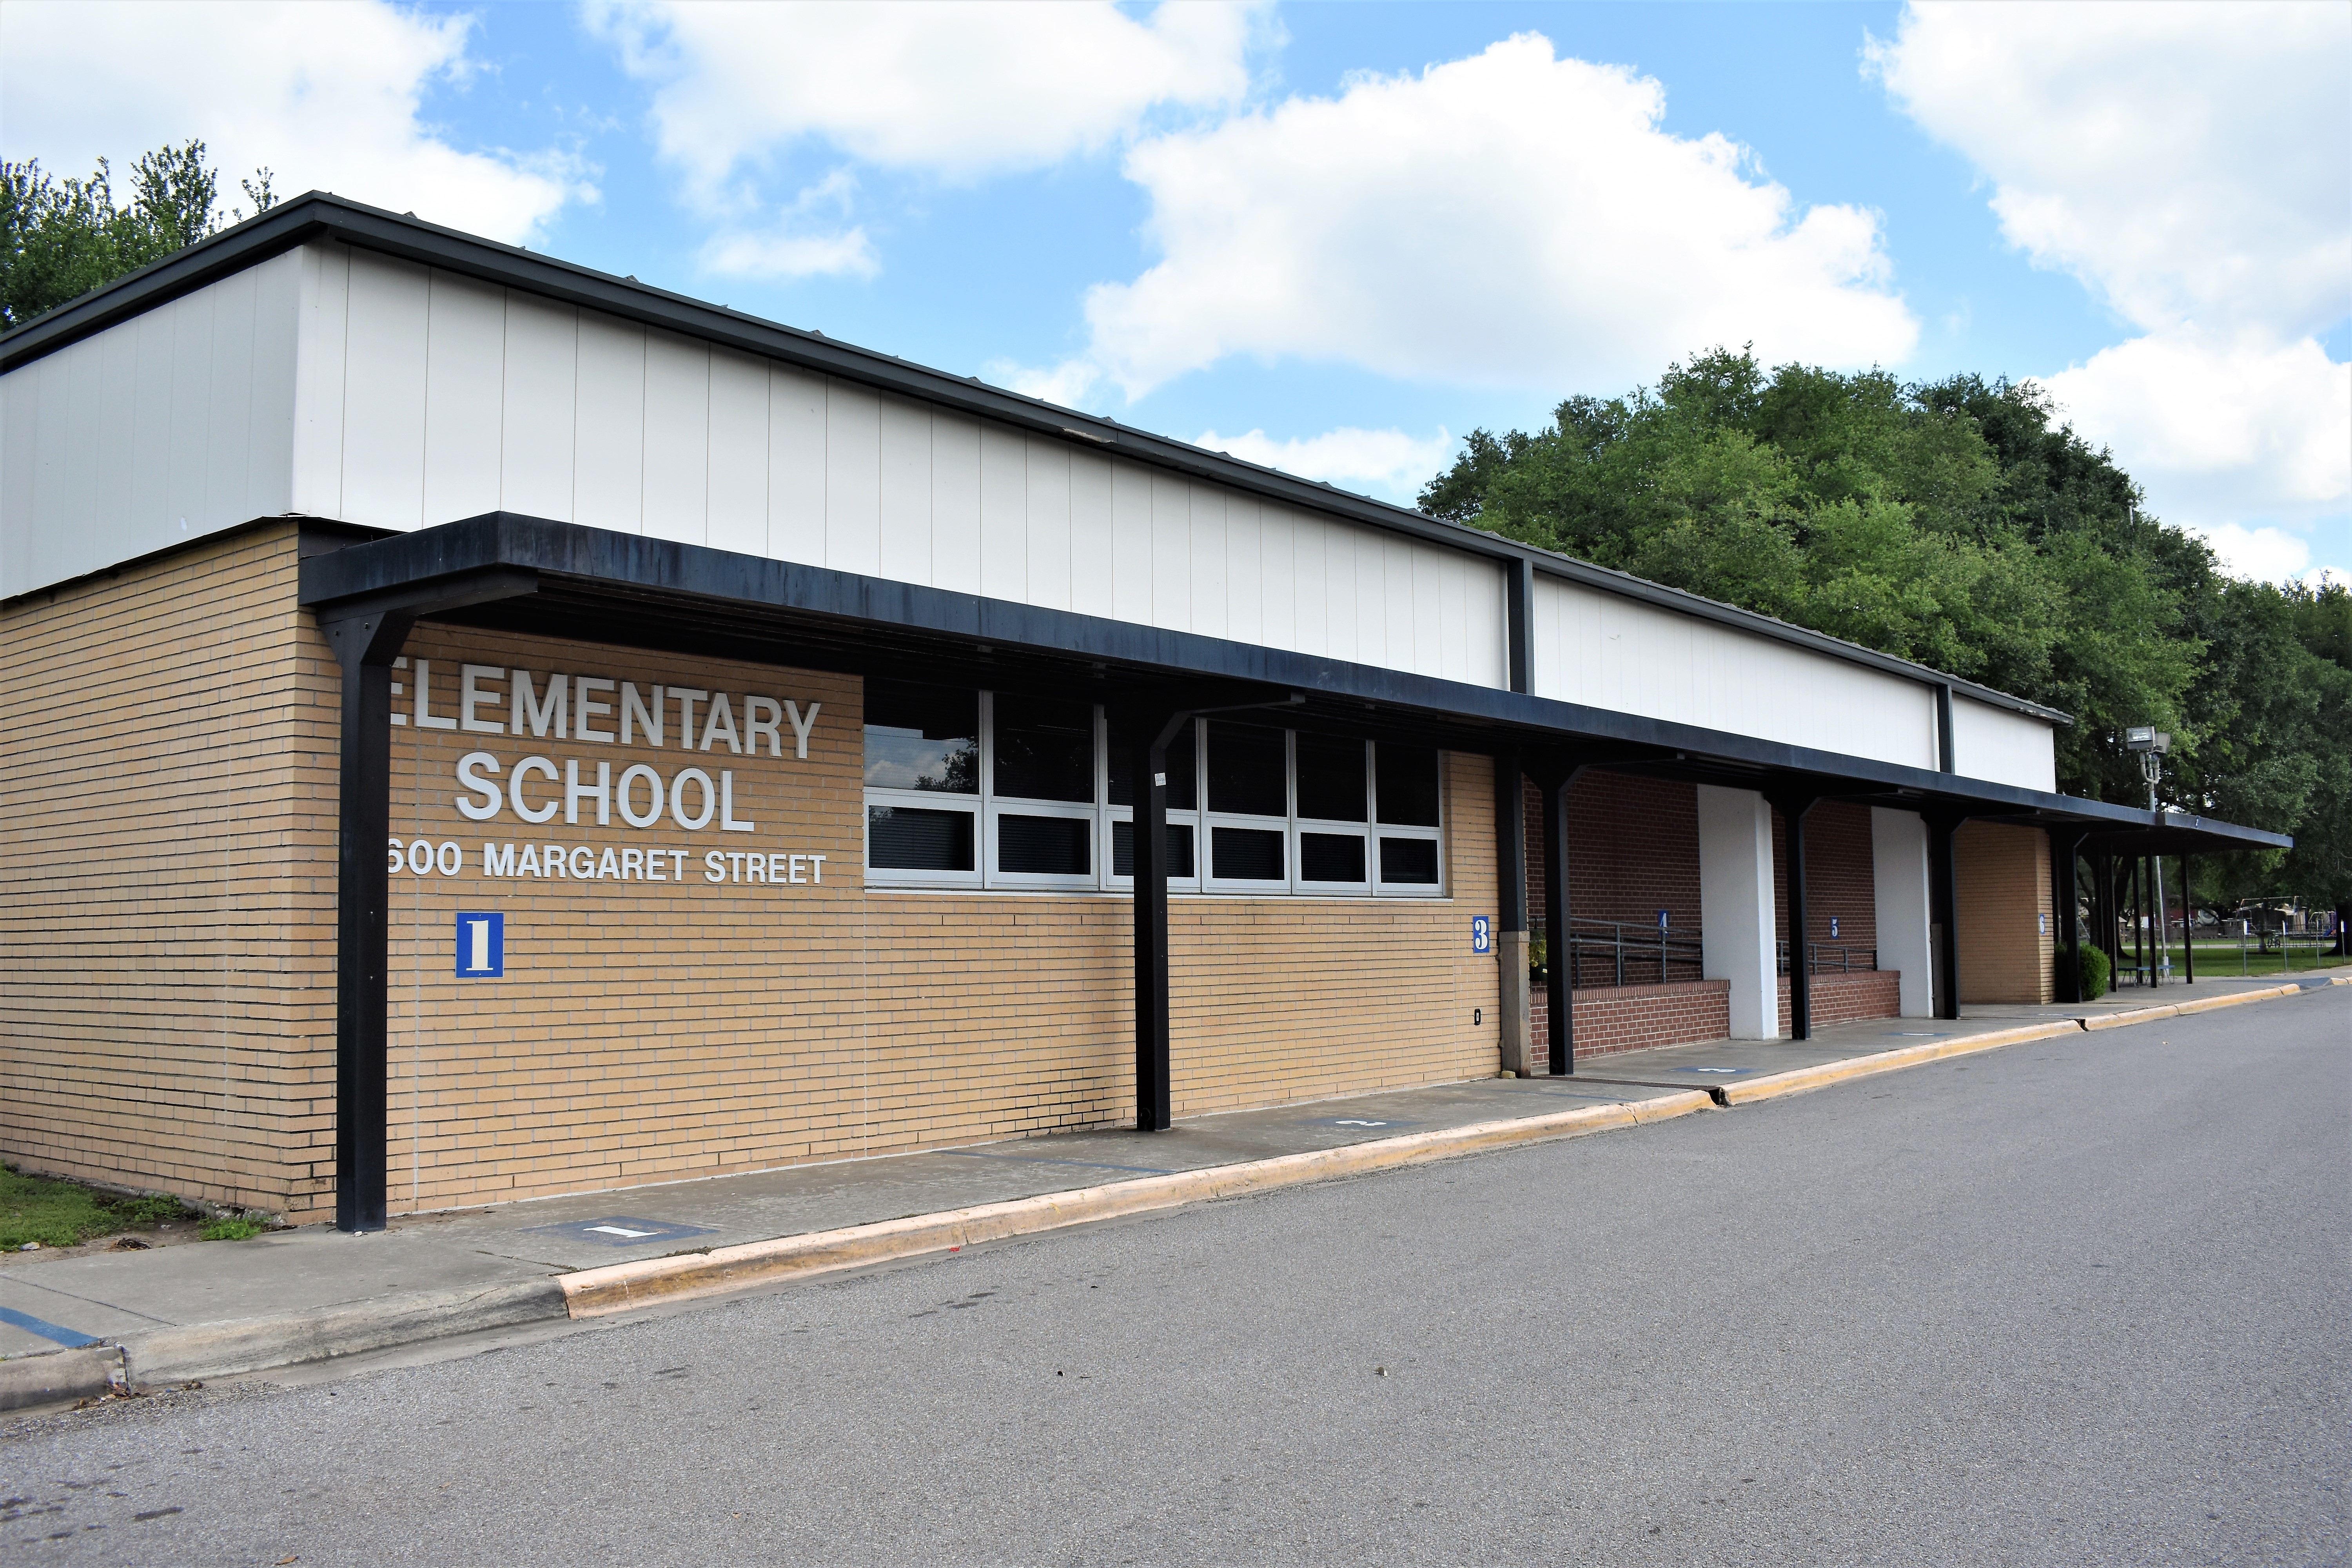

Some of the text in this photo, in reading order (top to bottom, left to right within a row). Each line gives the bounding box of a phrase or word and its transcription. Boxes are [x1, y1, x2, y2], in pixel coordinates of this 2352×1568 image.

[390, 656, 821, 759] LEMENTARY
[455, 752, 754, 831] SCHOOL
[388, 838, 826, 884] 600 MARGARET STREET
[466, 920, 493, 971] 1
[1475, 920, 1488, 949] 3
[1832, 919, 1838, 937] 5
[583, 1226, 657, 1238] 1
